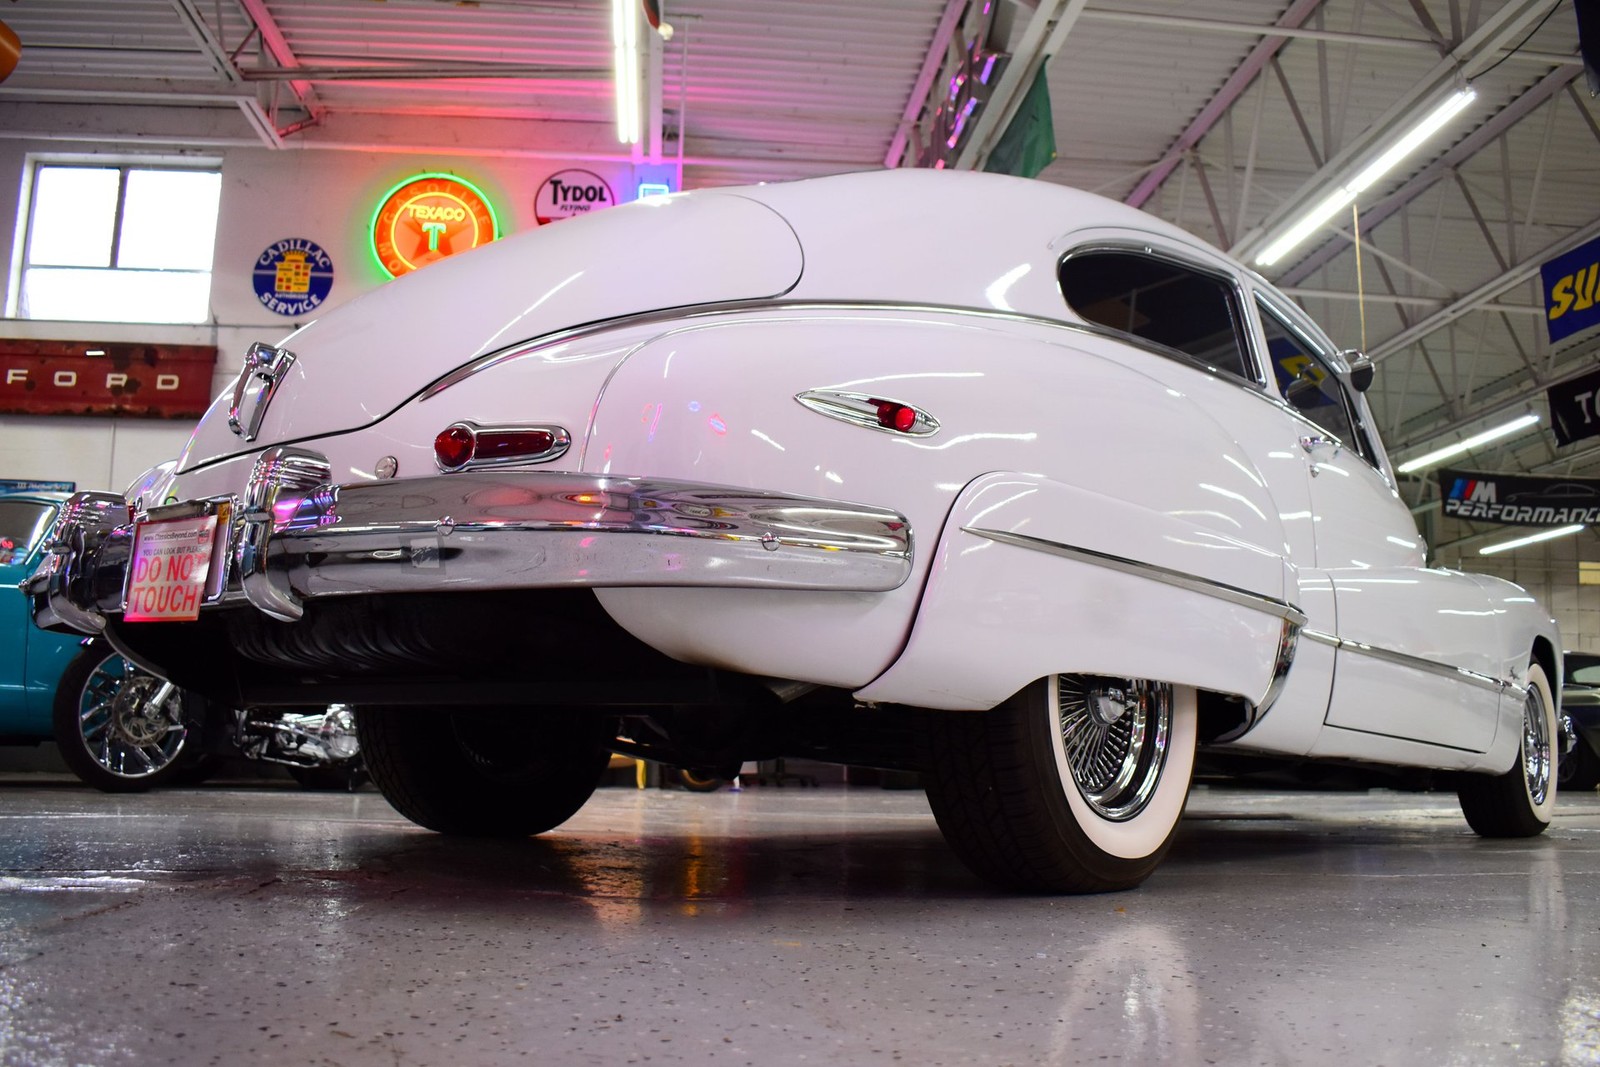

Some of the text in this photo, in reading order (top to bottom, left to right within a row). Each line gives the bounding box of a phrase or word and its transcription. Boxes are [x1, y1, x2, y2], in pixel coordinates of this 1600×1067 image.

[549, 179, 607, 205] TYDOL
[406, 204, 466, 221] TEXACO
[260, 240, 330, 268] CADILLAC
[260, 292, 321, 315] SERVICE
[1548, 262, 1600, 320] SU
[6, 369, 180, 390] FORD
[153, 548, 163, 556] CAN
[163, 547, 175, 555] LOOK
[176, 546, 186, 554] BUT
[136, 556, 162, 583] DO
[133, 585, 198, 613] TOUCH
